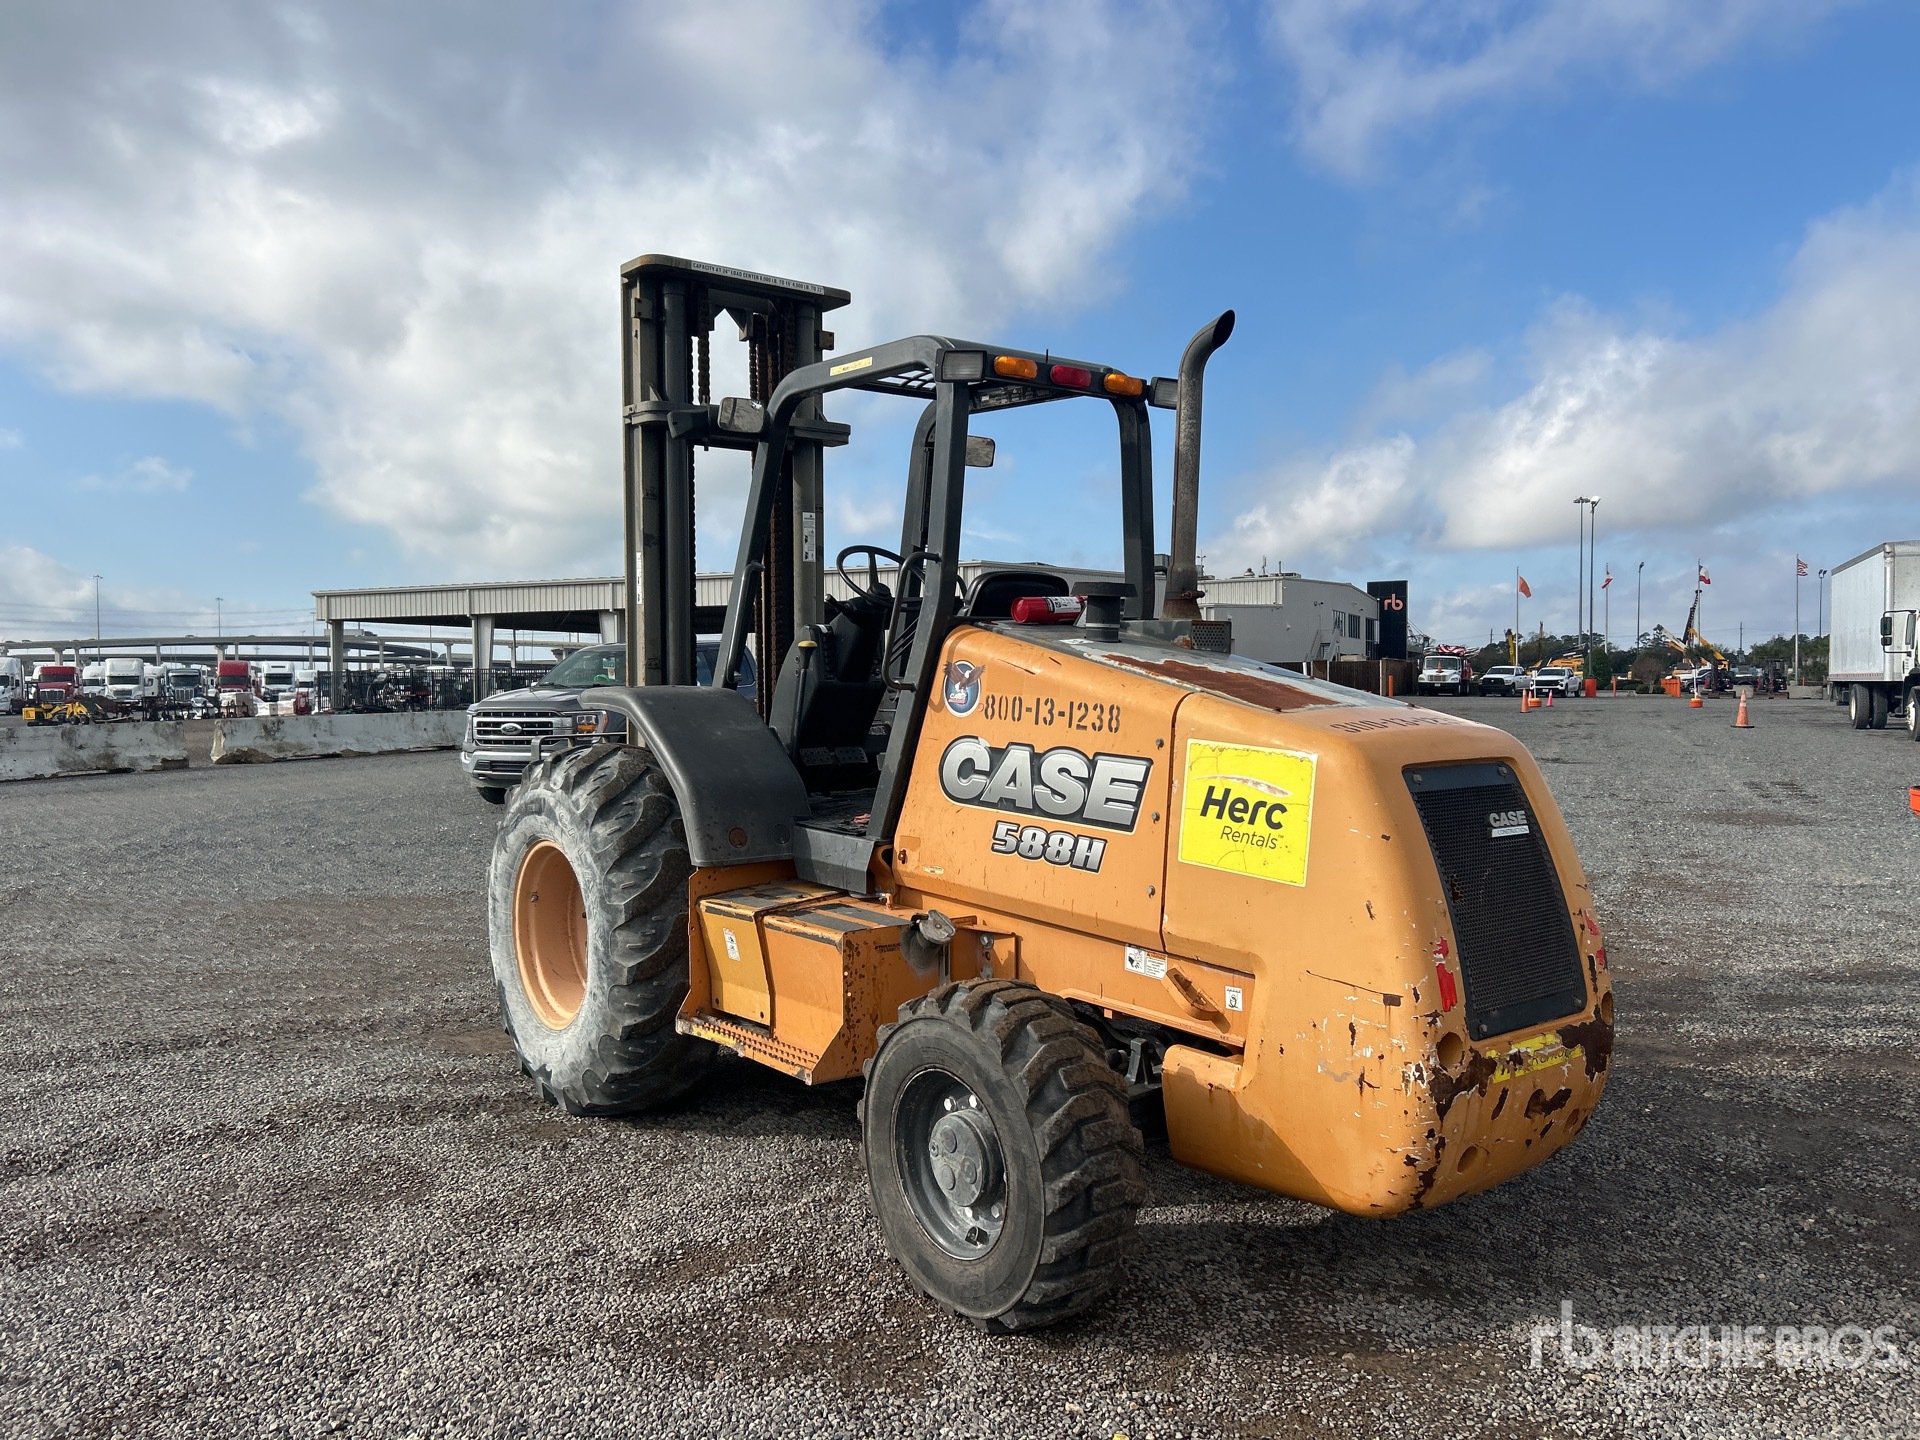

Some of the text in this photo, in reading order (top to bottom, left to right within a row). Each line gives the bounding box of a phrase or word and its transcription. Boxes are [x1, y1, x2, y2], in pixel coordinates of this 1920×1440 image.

[693, 262, 715, 272] CAPACITY
[743, 272, 759, 280] CENTER
[1384, 594, 1403, 610] rb
[984, 694, 1121, 734] 800-13-1238
[941, 737, 1151, 829] CASE
[1200, 785, 1288, 830] Herc
[1490, 810, 1528, 827] CASE
[991, 820, 1108, 873] 588H
[1220, 825, 1278, 849] Rentals
